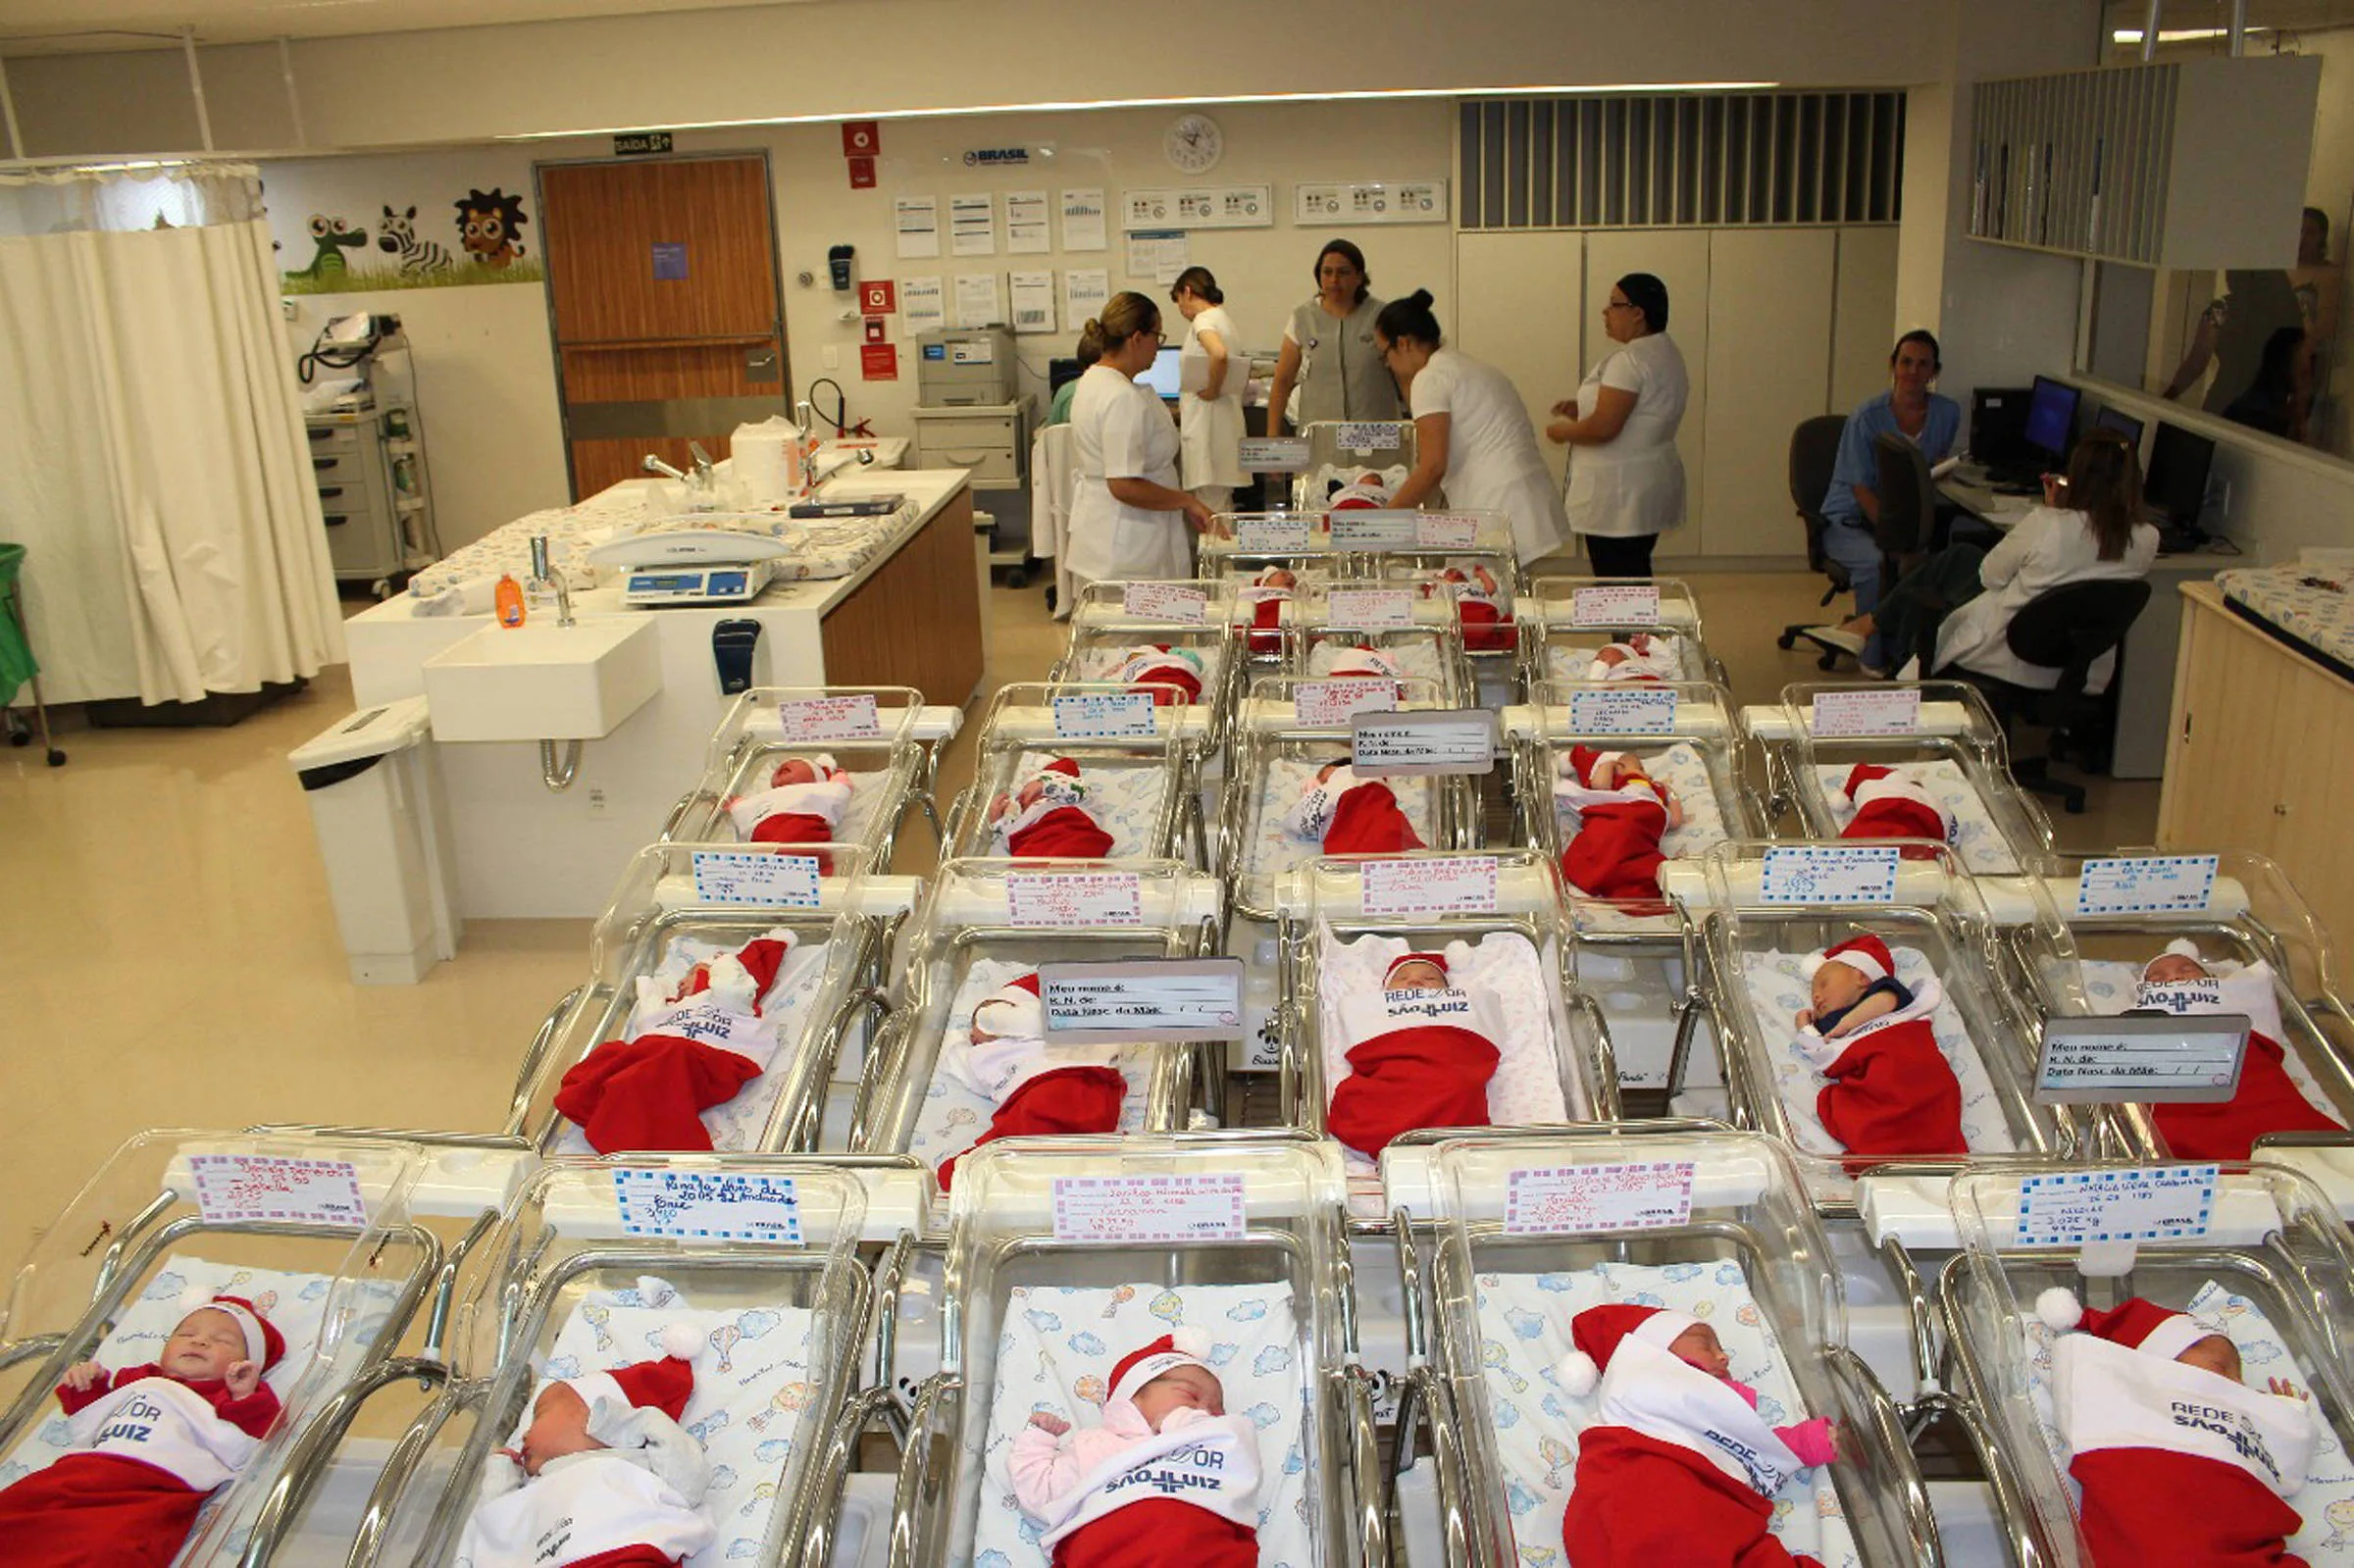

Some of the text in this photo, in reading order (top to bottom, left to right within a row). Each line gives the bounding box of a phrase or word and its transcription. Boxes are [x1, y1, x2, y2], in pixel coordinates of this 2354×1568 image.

[1049, 984, 1075, 993] Meu
[1050, 1007, 1079, 1017] Data
[2051, 1042, 2077, 1052] Meu
[2079, 1043, 2114, 1052] nome
[2047, 1067, 2074, 1077] Data
[2171, 1400, 2234, 1424] REDE
